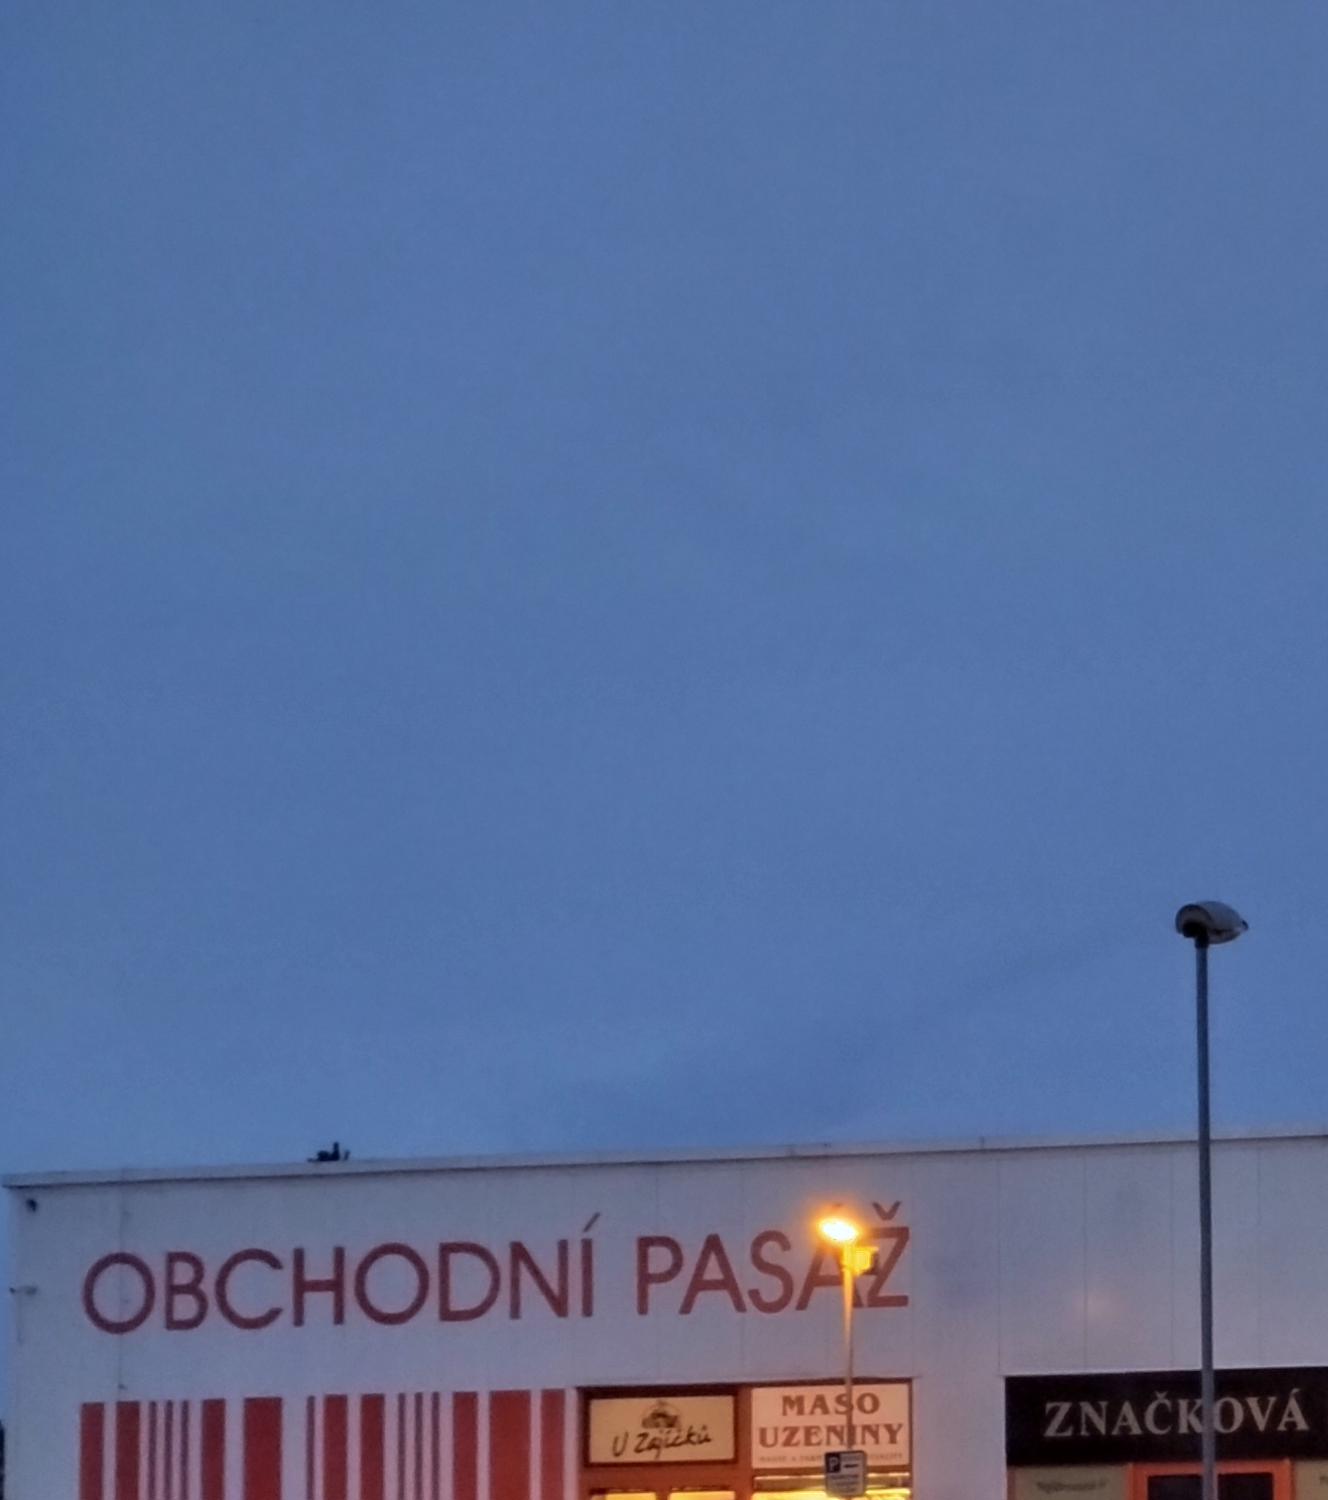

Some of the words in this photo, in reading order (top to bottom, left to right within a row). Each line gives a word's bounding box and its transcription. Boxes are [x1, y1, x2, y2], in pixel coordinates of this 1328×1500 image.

[81, 1211, 601, 1335] OBCHODNÍ
[782, 1391, 881, 1417] MASO
[1043, 1389, 1309, 1438] ZNAČKOVÁ
[758, 1423, 904, 1449] UZENINY
